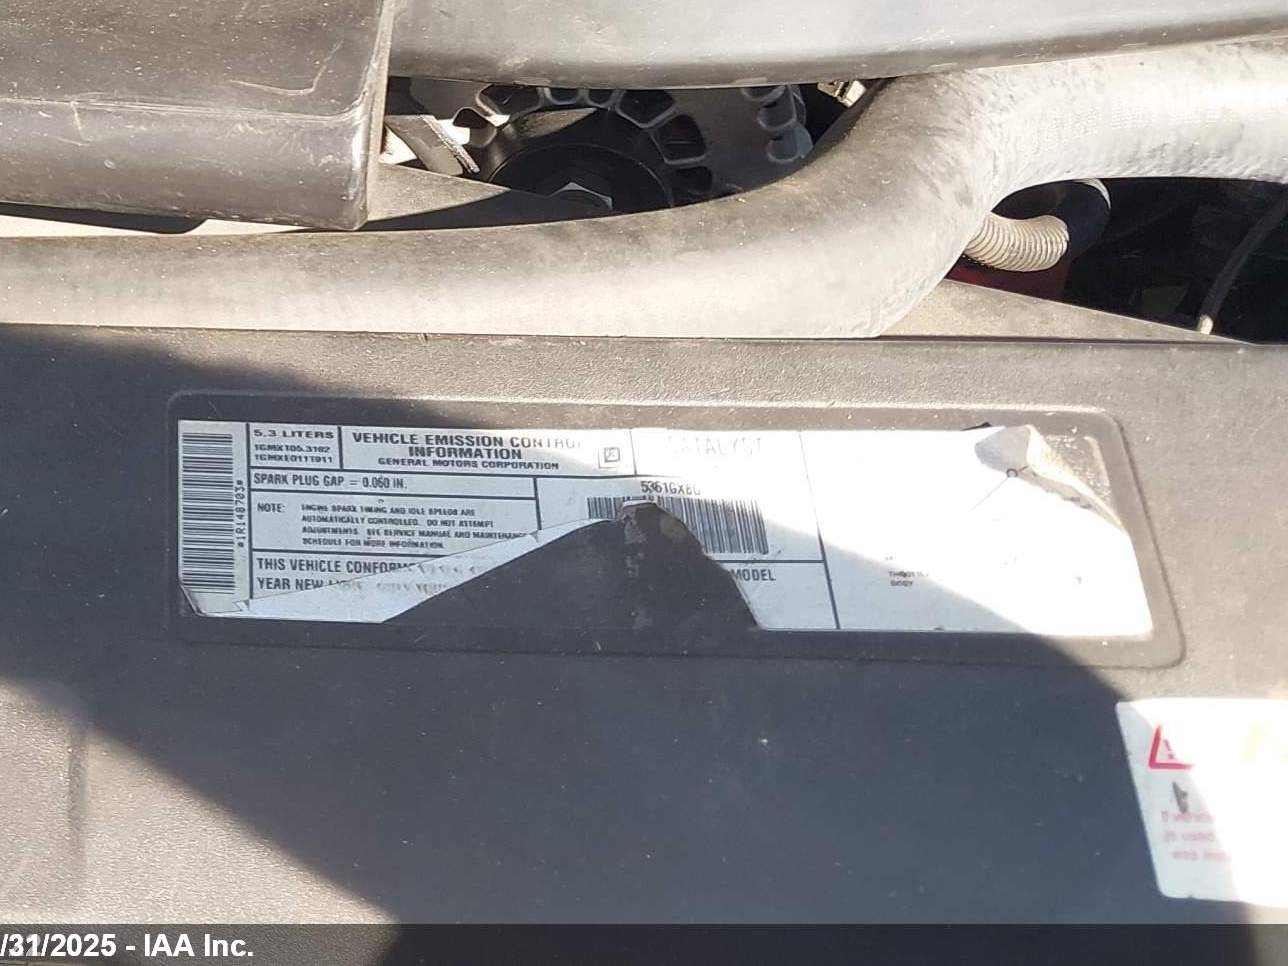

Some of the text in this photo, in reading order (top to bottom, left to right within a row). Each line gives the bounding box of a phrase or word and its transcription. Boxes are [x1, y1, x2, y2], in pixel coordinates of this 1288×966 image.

[253, 429, 335, 440] 5.3 LITERS
[352, 432, 419, 445] VEHICLE
[425, 434, 504, 448] EMISSION
[408, 446, 522, 460] INFORMATION
[378, 457, 560, 471] GENERAL MOTORS CORPORATION
[253, 472, 289, 485] SPARK
[292, 474, 320, 486] PLUG
[323, 475, 345, 487] GAP
[362, 476, 390, 489] 0.060
[392, 477, 408, 490] IN.
[257, 503, 286, 513] NOTE:
[301, 504, 329, 512] ENGINE
[332, 504, 358, 513] SPARK
[360, 505, 388, 514] TIMING
[390, 507, 407, 515] AND
[408, 507, 425, 515] IDLE
[460, 508, 476, 516] ARE
[301, 515, 365, 524] AUTOMATICALLY
[426, 519, 438, 527] DO
[440, 519, 456, 528] NOT
[458, 520, 494, 528] ATTEMPT
[383, 529, 416, 537] SERVICE
[418, 530, 452, 538] MANUAL
[454, 531, 471, 539] AND
[302, 537, 342, 546] SCHEDULE
[345, 538, 361, 547] FOR
[256, 557, 286, 571] THIS
[290, 559, 342, 573] VEHICLE
[730, 568, 776, 582] MODEL
[256, 577, 291, 591] YEAR
[295, 578, 324, 591] NEW
